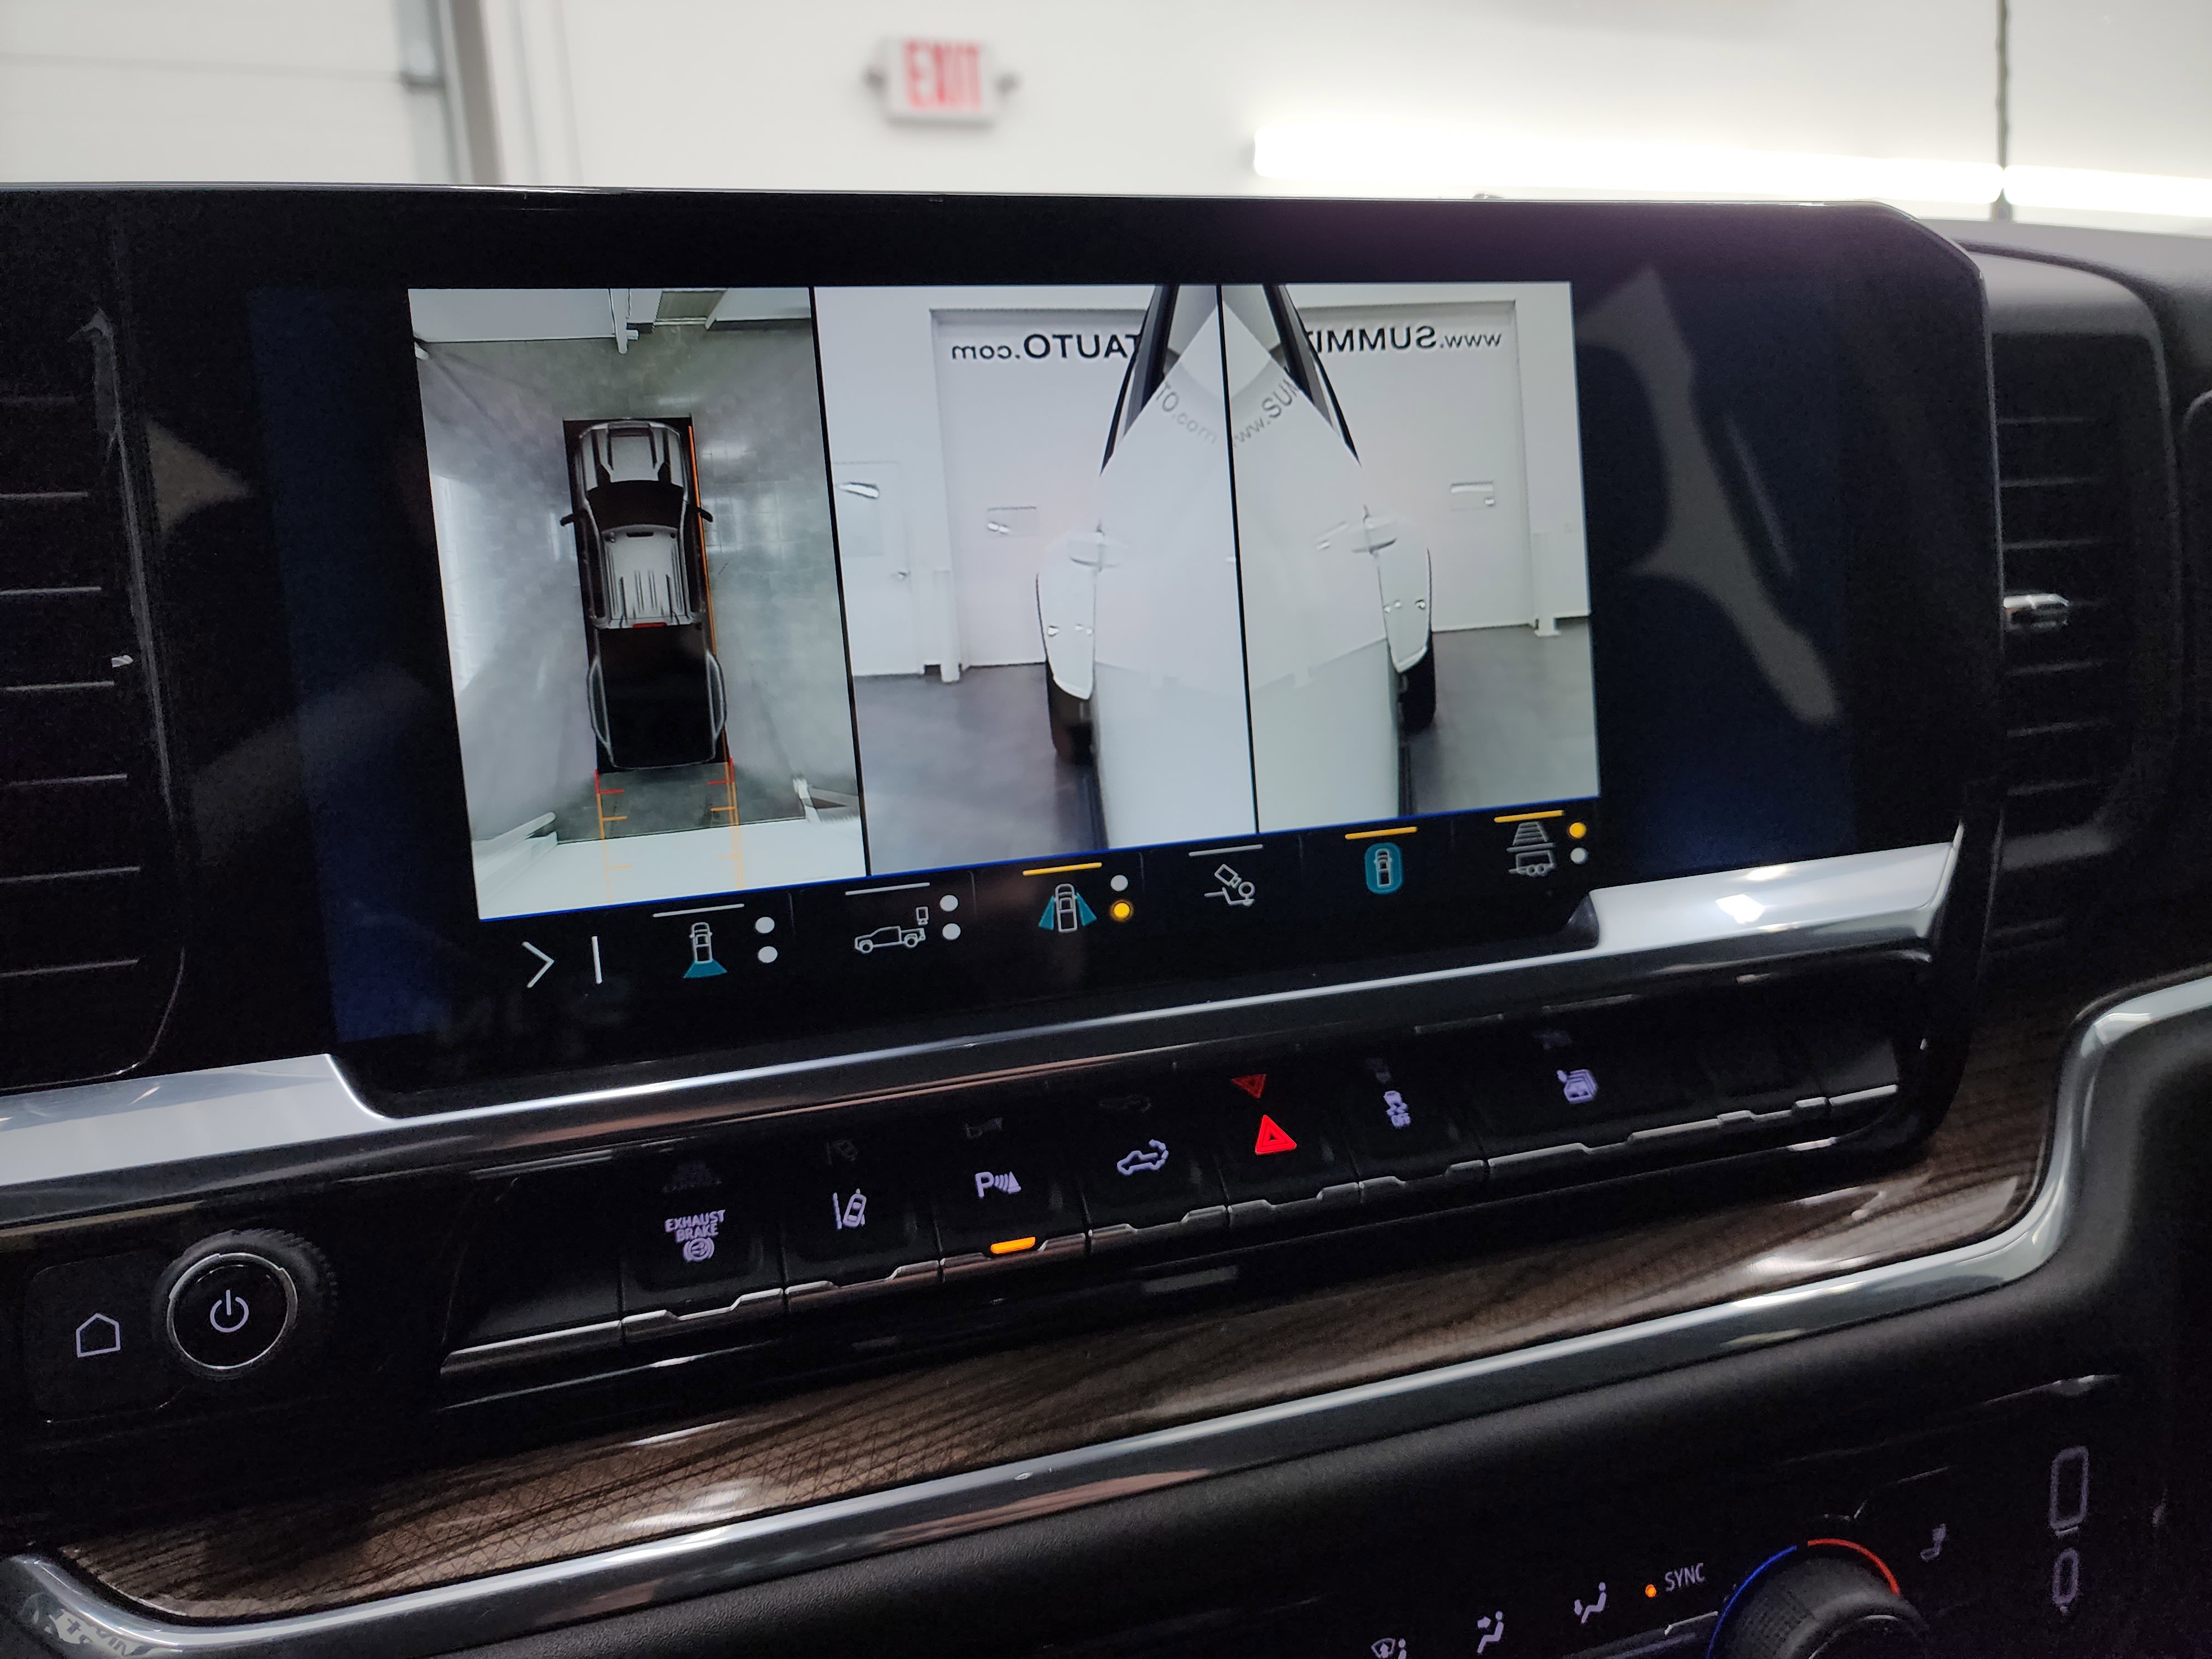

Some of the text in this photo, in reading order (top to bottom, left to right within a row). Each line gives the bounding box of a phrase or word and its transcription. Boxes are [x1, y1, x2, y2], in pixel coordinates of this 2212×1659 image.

[904, 40, 982, 111] EXIT
[665, 1209, 726, 1233] EXHAUST
[675, 1223, 719, 1243] BRAKE
[1664, 1562, 1705, 1592] SYNC
